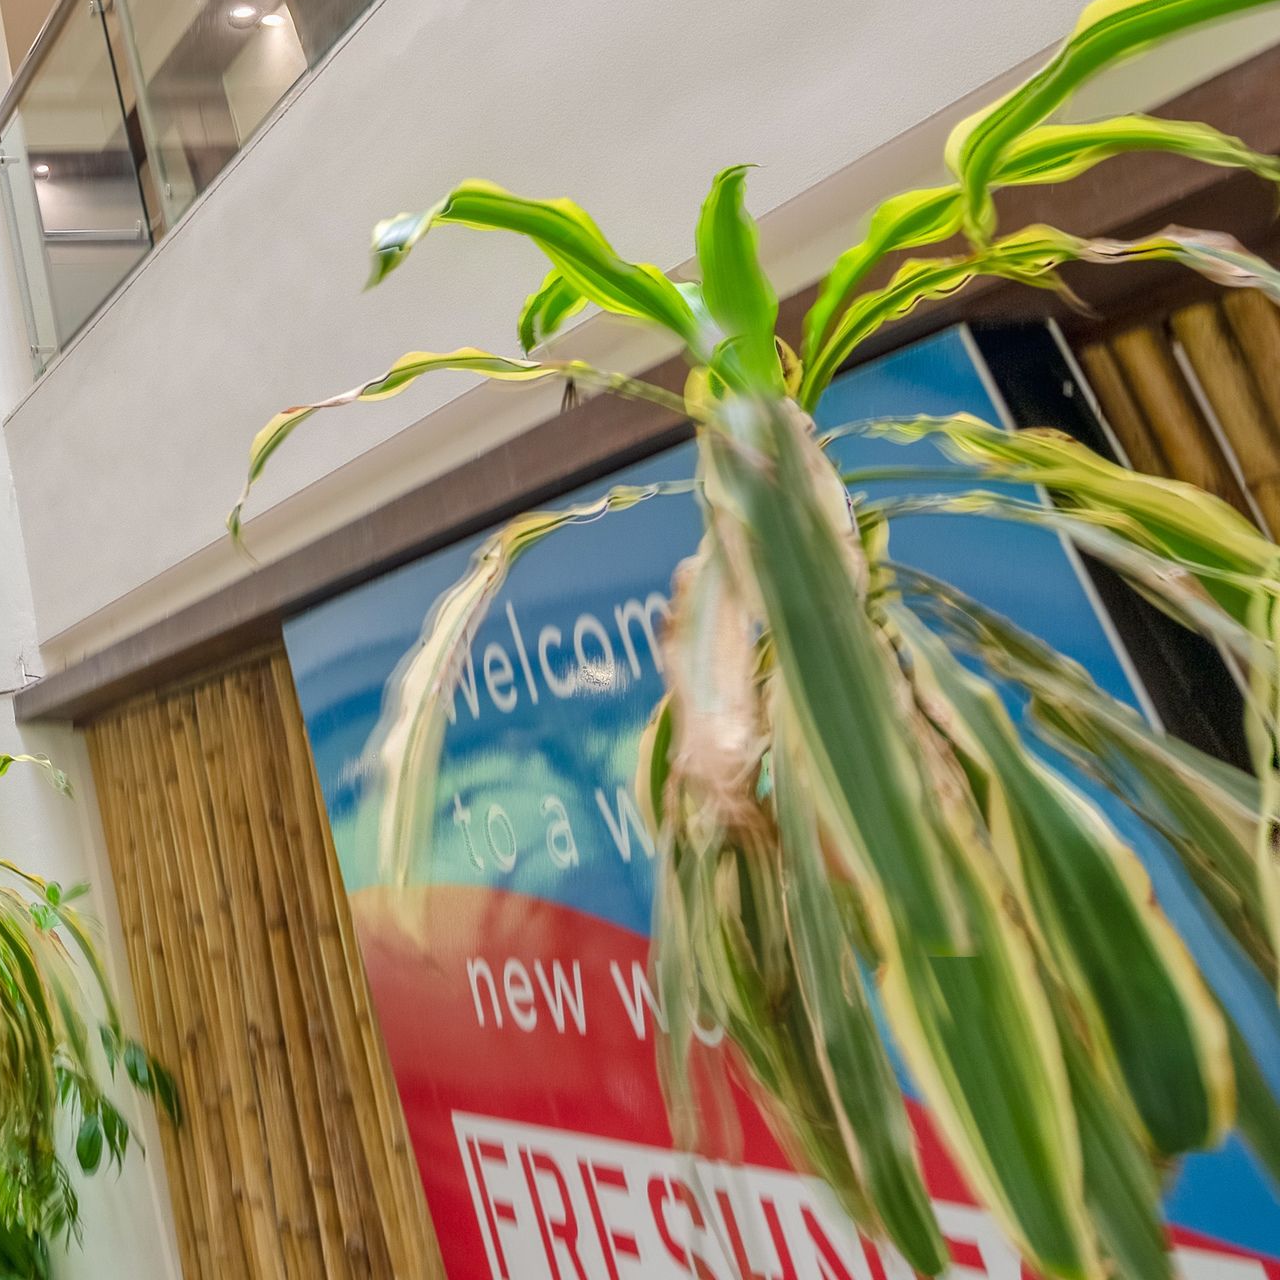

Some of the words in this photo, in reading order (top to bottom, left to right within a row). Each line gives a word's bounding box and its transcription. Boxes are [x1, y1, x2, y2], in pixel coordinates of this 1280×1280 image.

[439, 592, 672, 724] Welcom
[453, 793, 517, 871] to
[541, 795, 579, 869] a
[466, 956, 587, 1037] new
